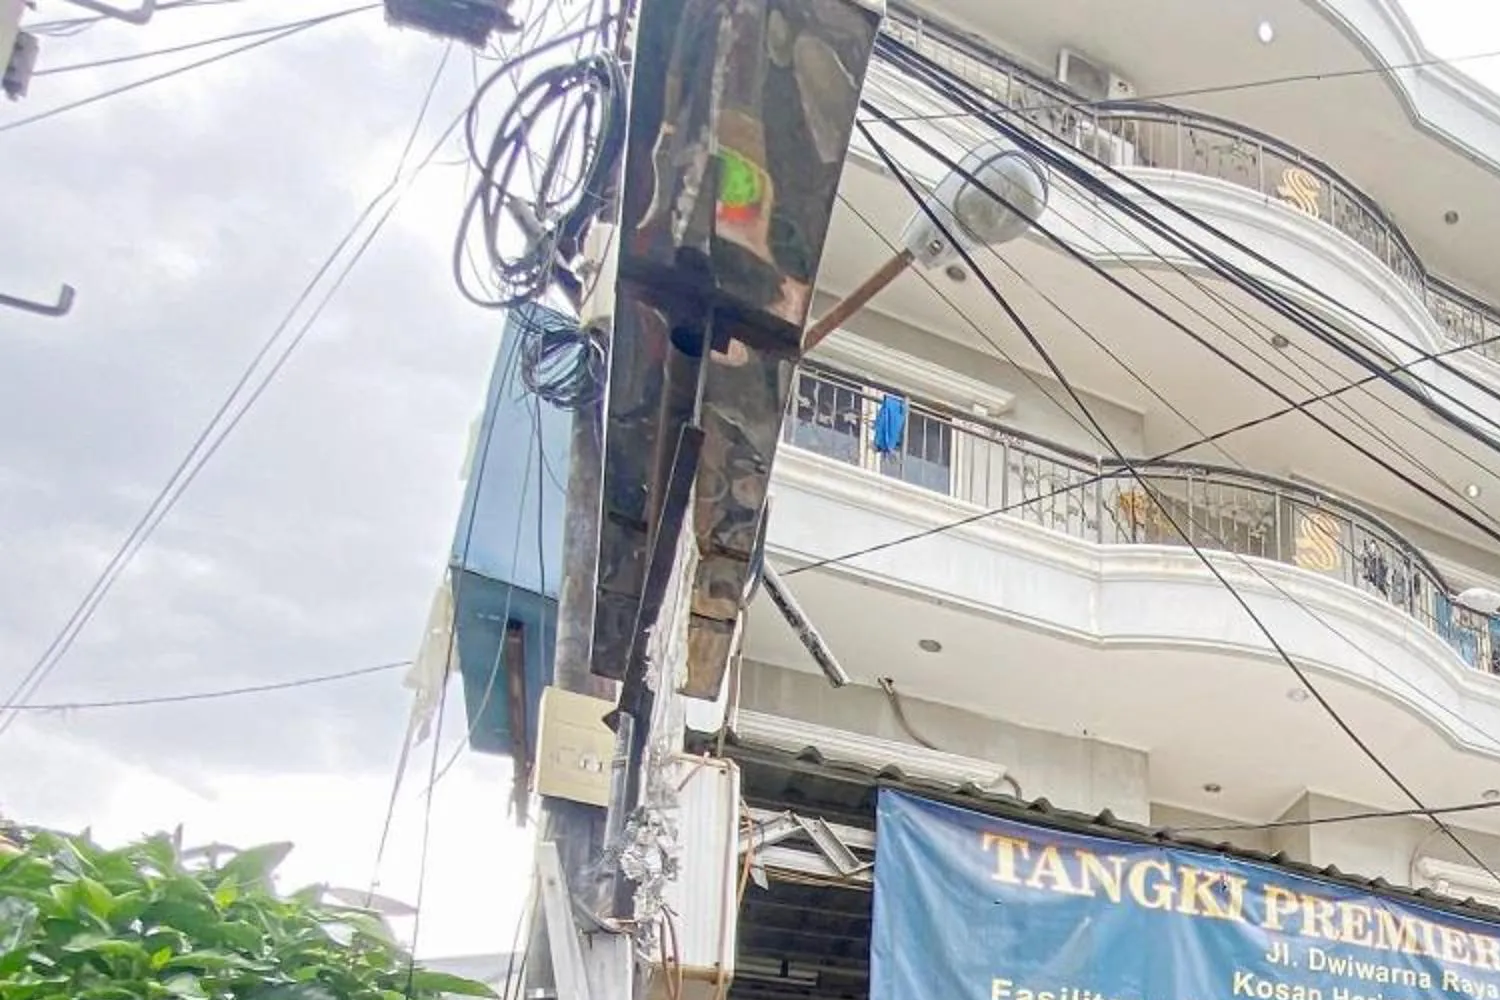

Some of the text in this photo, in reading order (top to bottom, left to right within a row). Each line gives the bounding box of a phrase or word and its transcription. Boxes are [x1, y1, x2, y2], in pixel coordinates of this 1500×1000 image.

[981, 830, 1248, 923] TANGKI
[1266, 943, 1298, 967] Jl.
[1308, 948, 1431, 990] Dwiwarna
